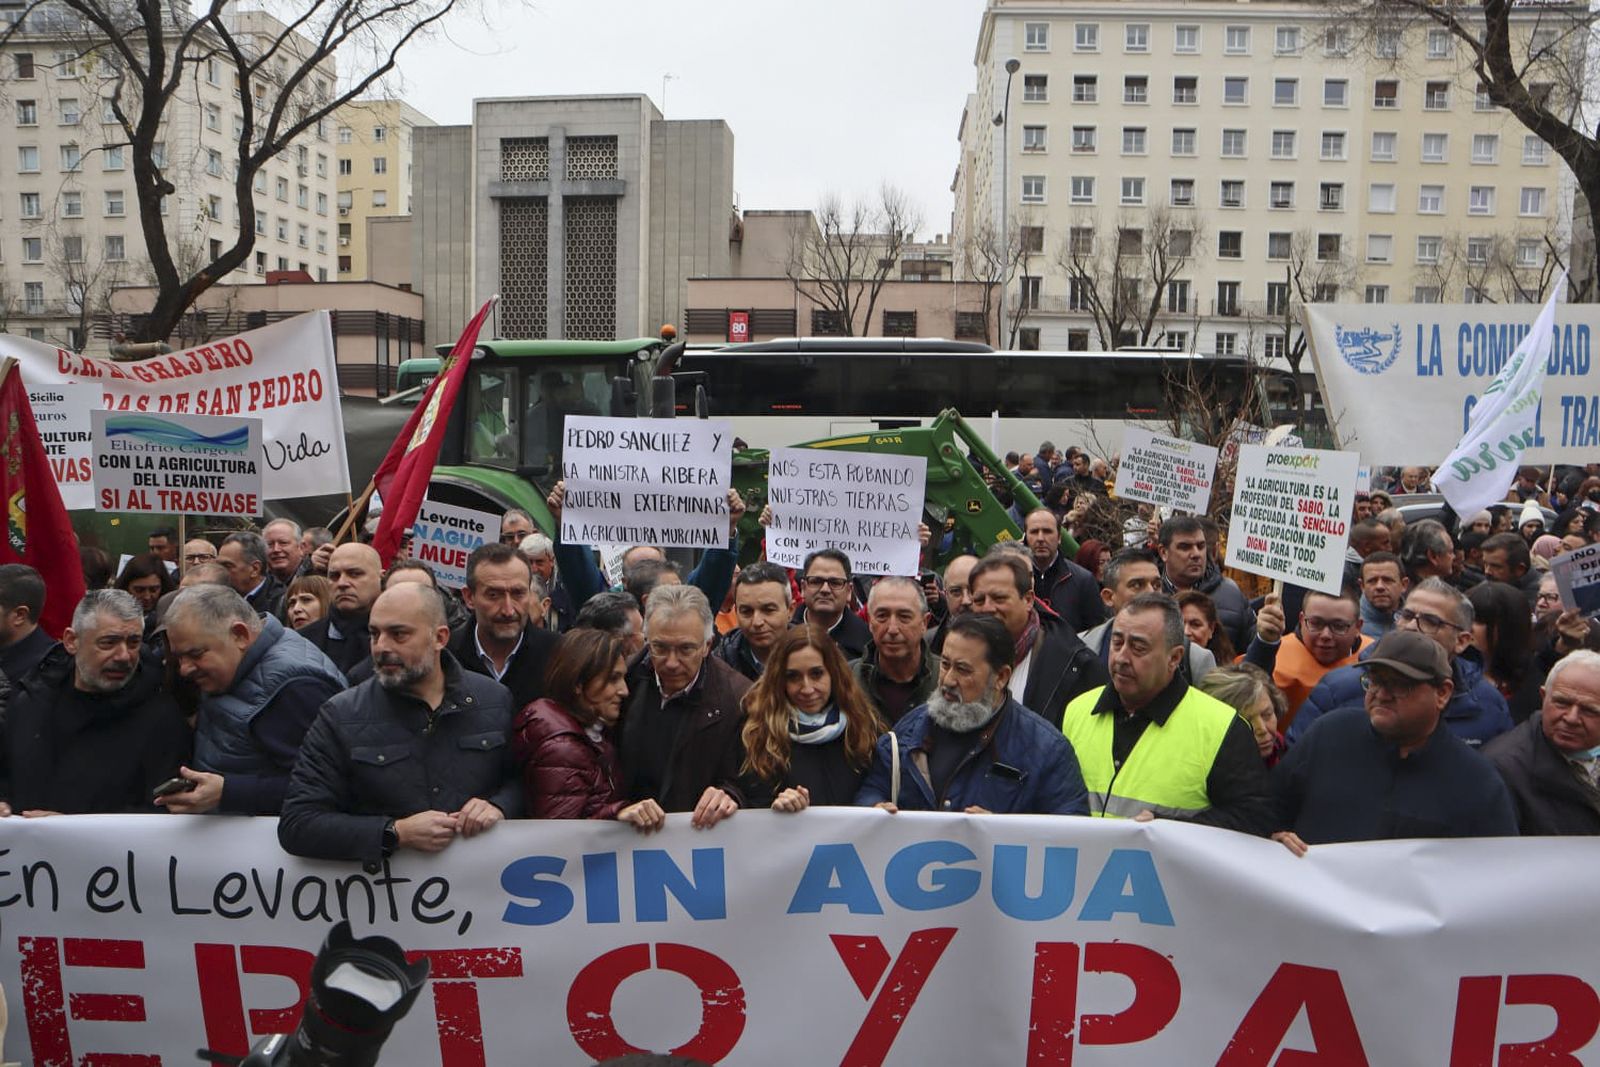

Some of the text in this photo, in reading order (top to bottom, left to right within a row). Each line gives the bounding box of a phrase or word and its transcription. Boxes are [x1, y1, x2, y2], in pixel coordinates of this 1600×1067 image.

[732, 322, 746, 334] 80
[132, 338, 253, 382] GRAJERO
[1416, 324, 1442, 376] LA
[196, 384, 242, 416] SAN
[248, 369, 322, 411] PEDRO
[111, 440, 174, 452] Eliofrio
[179, 443, 228, 457] Cargo
[262, 432, 330, 470] Vida
[568, 428, 722, 452] PEDRO SANCHEZ Y
[99, 454, 256, 474] CON LA AGRICULTURA
[1144, 450, 1184, 466] AGRICULTURA
[1188, 460, 1195, 468] ES
[1162, 462, 1173, 472] DEL
[1266, 452, 1320, 469] proexport
[134, 473, 225, 488] DEL LEVANTE
[563, 462, 718, 486] LA MINISTRA RIBERA
[772, 459, 914, 487] NOS ESTA ROBANDO
[1180, 476, 1209, 488] SENCILLO
[101, 488, 256, 513] SI AL TRASVASE
[771, 488, 910, 512] NUESTRAS TIERRAS
[1154, 486, 1170, 495] PARA
[1258, 478, 1310, 496] AGRICULTURA
[1314, 485, 1324, 499] ES
[1328, 487, 1338, 501] LA
[565, 490, 726, 515] QUIEREN EXTERMINAR
[1280, 496, 1294, 510] DEL
[1298, 499, 1324, 517] SABIO,
[1329, 504, 1339, 518] LA
[420, 508, 484, 532] Levante
[789, 514, 850, 535] MINISTRA
[858, 520, 912, 539] RIBERA
[1244, 520, 1248, 532] Y
[1250, 522, 1258, 534] LA
[1249, 508, 1286, 524] ADECUADA
[1290, 514, 1298, 528] AL
[1302, 517, 1345, 536] SENCILLO
[431, 528, 484, 550] AGUA
[562, 523, 720, 544] LA AGRICULTURA MURCIANA
[775, 537, 872, 552] CON SU TEORIA
[1236, 549, 1264, 566] HOMBRE
[1246, 536, 1316, 563] DIGNA PARA TODO
[855, 561, 891, 572] MENOR
[86, 850, 135, 913] el
[170, 857, 473, 936] Levante,
[502, 848, 727, 926] SIN
[789, 841, 1176, 927] AGUA
[828, 927, 958, 1067] Y
